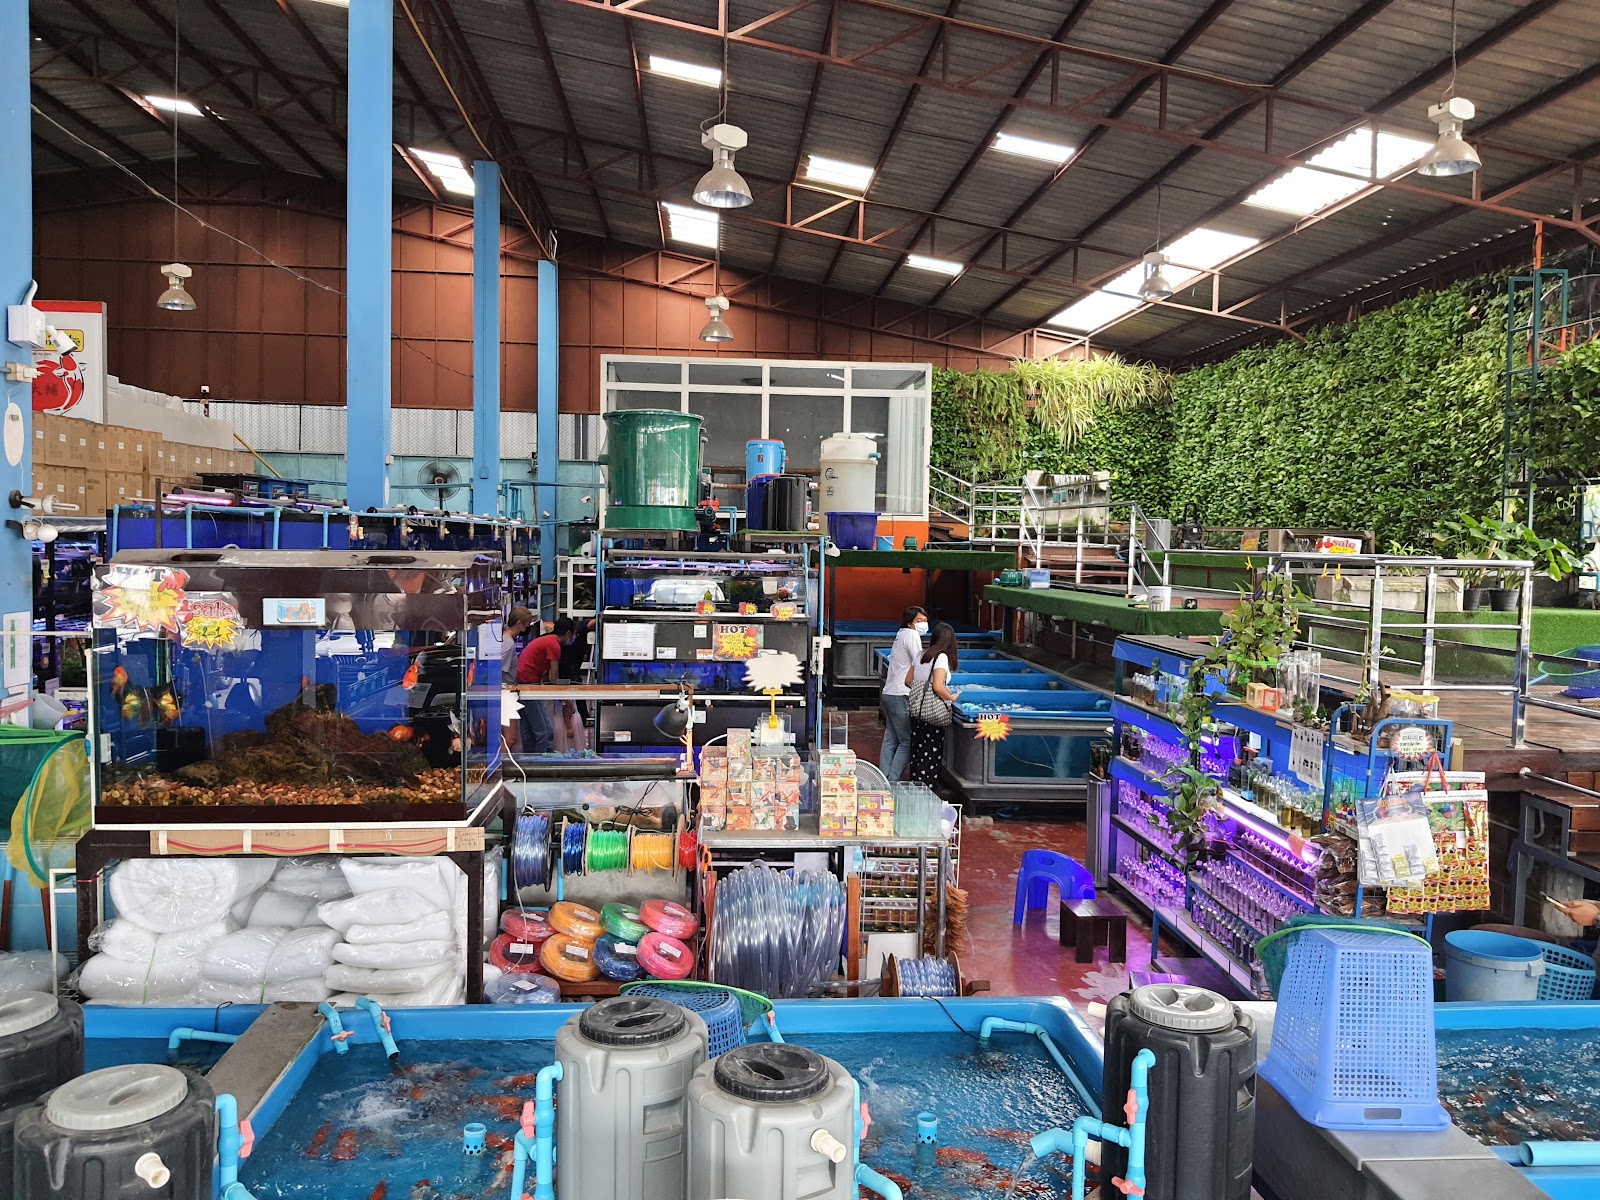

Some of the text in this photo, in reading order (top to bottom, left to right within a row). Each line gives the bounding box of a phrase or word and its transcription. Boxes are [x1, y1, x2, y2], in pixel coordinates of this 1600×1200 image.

[1332, 540, 1356, 548] sale
[191, 600, 234, 617] sale
[720, 625, 747, 633] HOT
